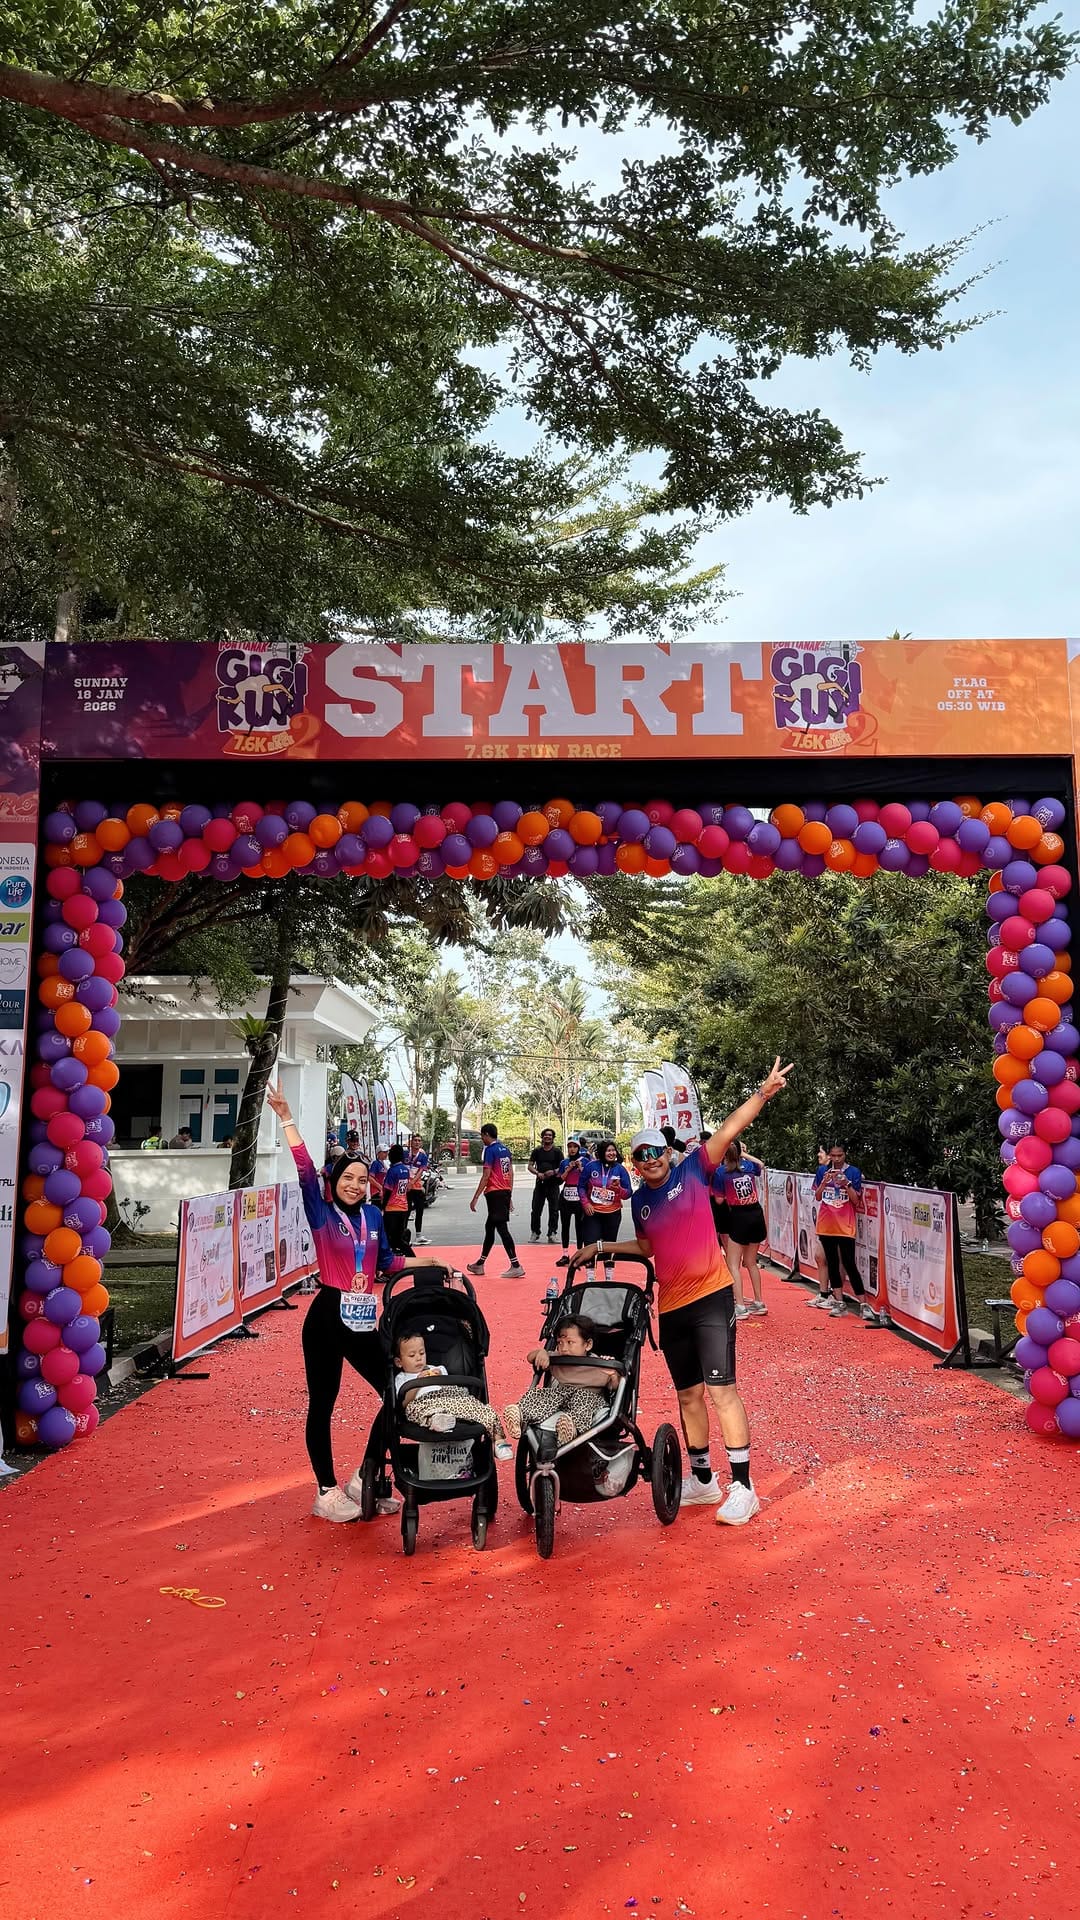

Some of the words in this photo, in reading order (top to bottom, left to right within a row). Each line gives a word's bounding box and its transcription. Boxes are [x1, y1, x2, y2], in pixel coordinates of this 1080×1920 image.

[217, 649, 308, 695] GIGI
[771, 647, 862, 693] GIGI
[74, 678, 128, 687] SUNDAY
[953, 678, 987, 687] FLAG
[77, 690, 92, 699] 18
[96, 690, 124, 699] JAN
[325, 643, 763, 737] START
[947, 689, 971, 699] OFF
[976, 689, 994, 699] AT
[84, 702, 116, 711] 2026
[218, 686, 304, 731] RUN
[774, 684, 860, 728] RUN
[937, 701, 973, 711] 05:30
[977, 701, 1006, 711] WIB
[233, 734, 267, 753] 7.6K
[791, 731, 825, 750] 7.6K
[464, 744, 510, 759] 7.6K
[517, 744, 560, 759] FUN
[567, 743, 622, 758] RACE
[6, 880, 26, 888] Pure
[8, 888, 23, 897] Life
